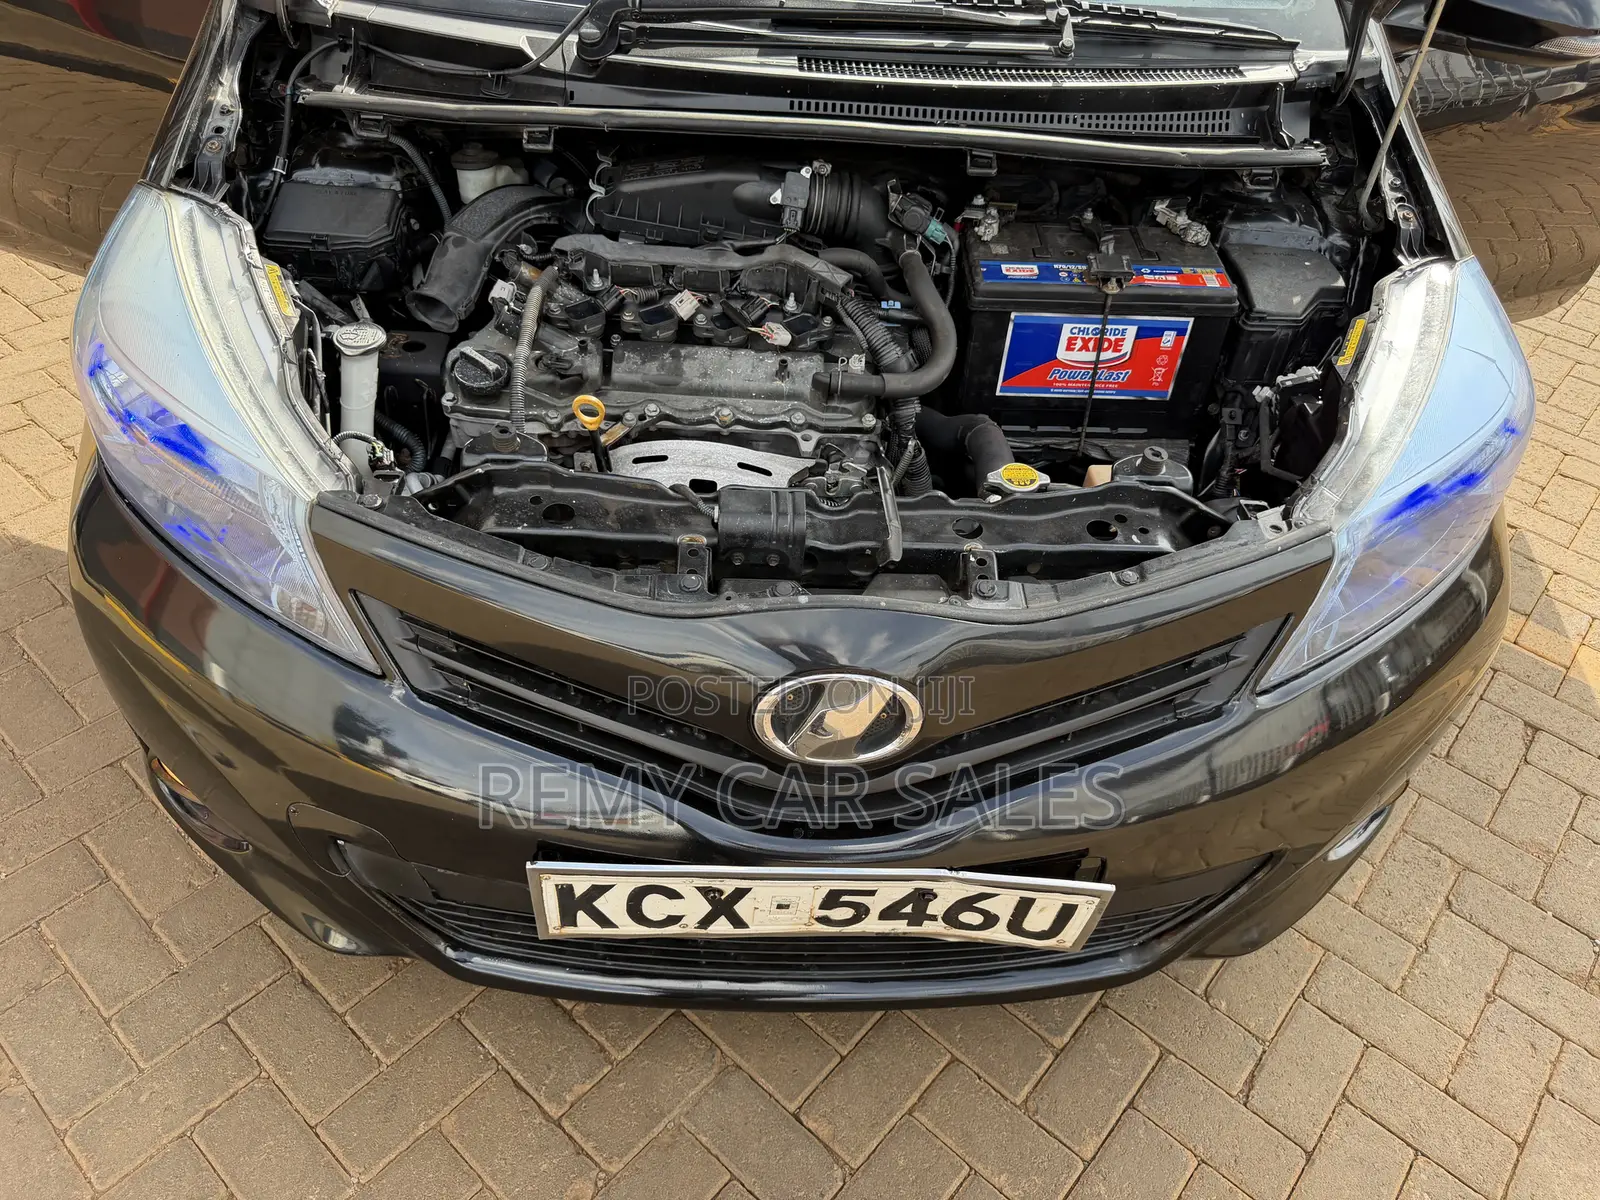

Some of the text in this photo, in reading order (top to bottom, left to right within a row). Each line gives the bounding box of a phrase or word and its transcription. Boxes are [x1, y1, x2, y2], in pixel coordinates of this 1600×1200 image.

[1069, 326, 1129, 337] CHLORIDE
[1065, 336, 1126, 353] EXIDE
[554, 884, 1079, 941] KCX 546U
